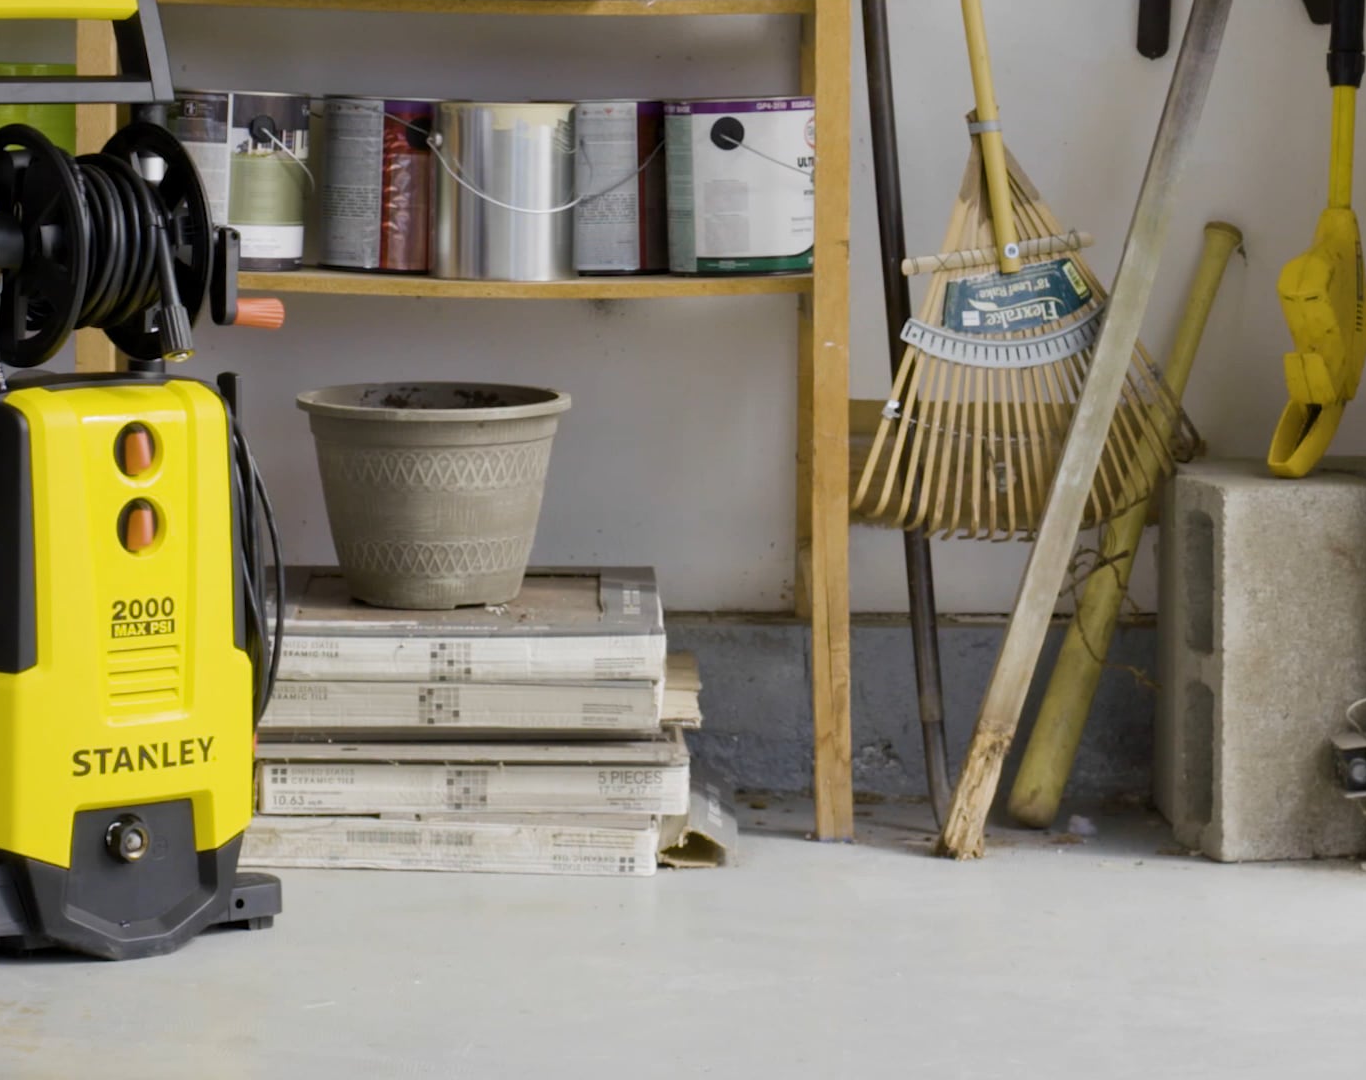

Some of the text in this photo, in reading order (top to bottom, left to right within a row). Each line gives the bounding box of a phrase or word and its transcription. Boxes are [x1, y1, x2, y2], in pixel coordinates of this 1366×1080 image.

[979, 286, 1007, 300] Rake
[1009, 281, 1032, 295] Leaf
[985, 300, 1059, 329] Flexrake
[112, 597, 175, 621] 2000
[114, 620, 172, 637] MAX PSI
[72, 736, 213, 777] STANLEY
[291, 777, 355, 785] CERAMIC TILE
[598, 771, 663, 784] 5 PIECES
[272, 796, 305, 806] 10.63
